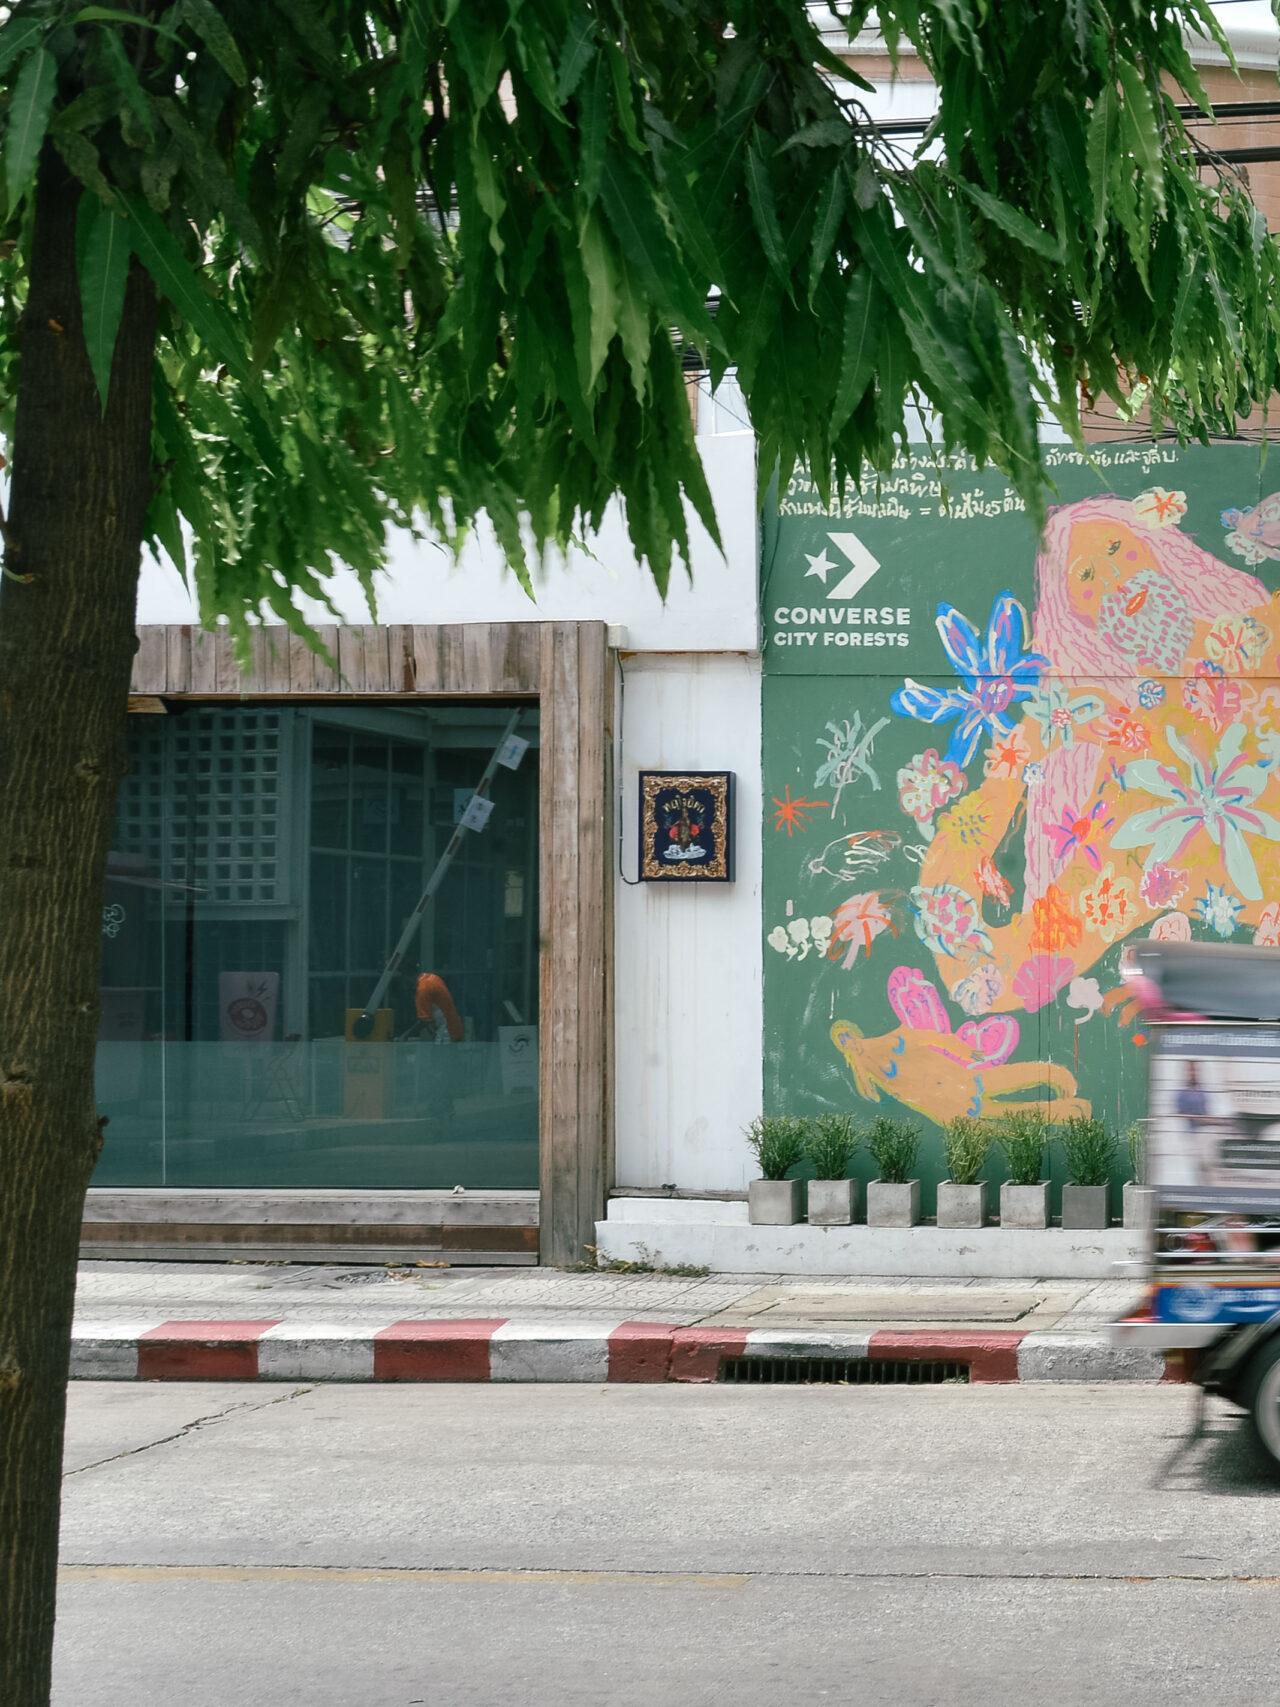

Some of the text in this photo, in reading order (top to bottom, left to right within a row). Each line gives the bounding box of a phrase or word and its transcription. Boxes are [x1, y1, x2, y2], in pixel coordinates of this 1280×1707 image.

[773, 607, 911, 625] CONVERSE
[773, 632, 910, 647] CITY FORESTS
